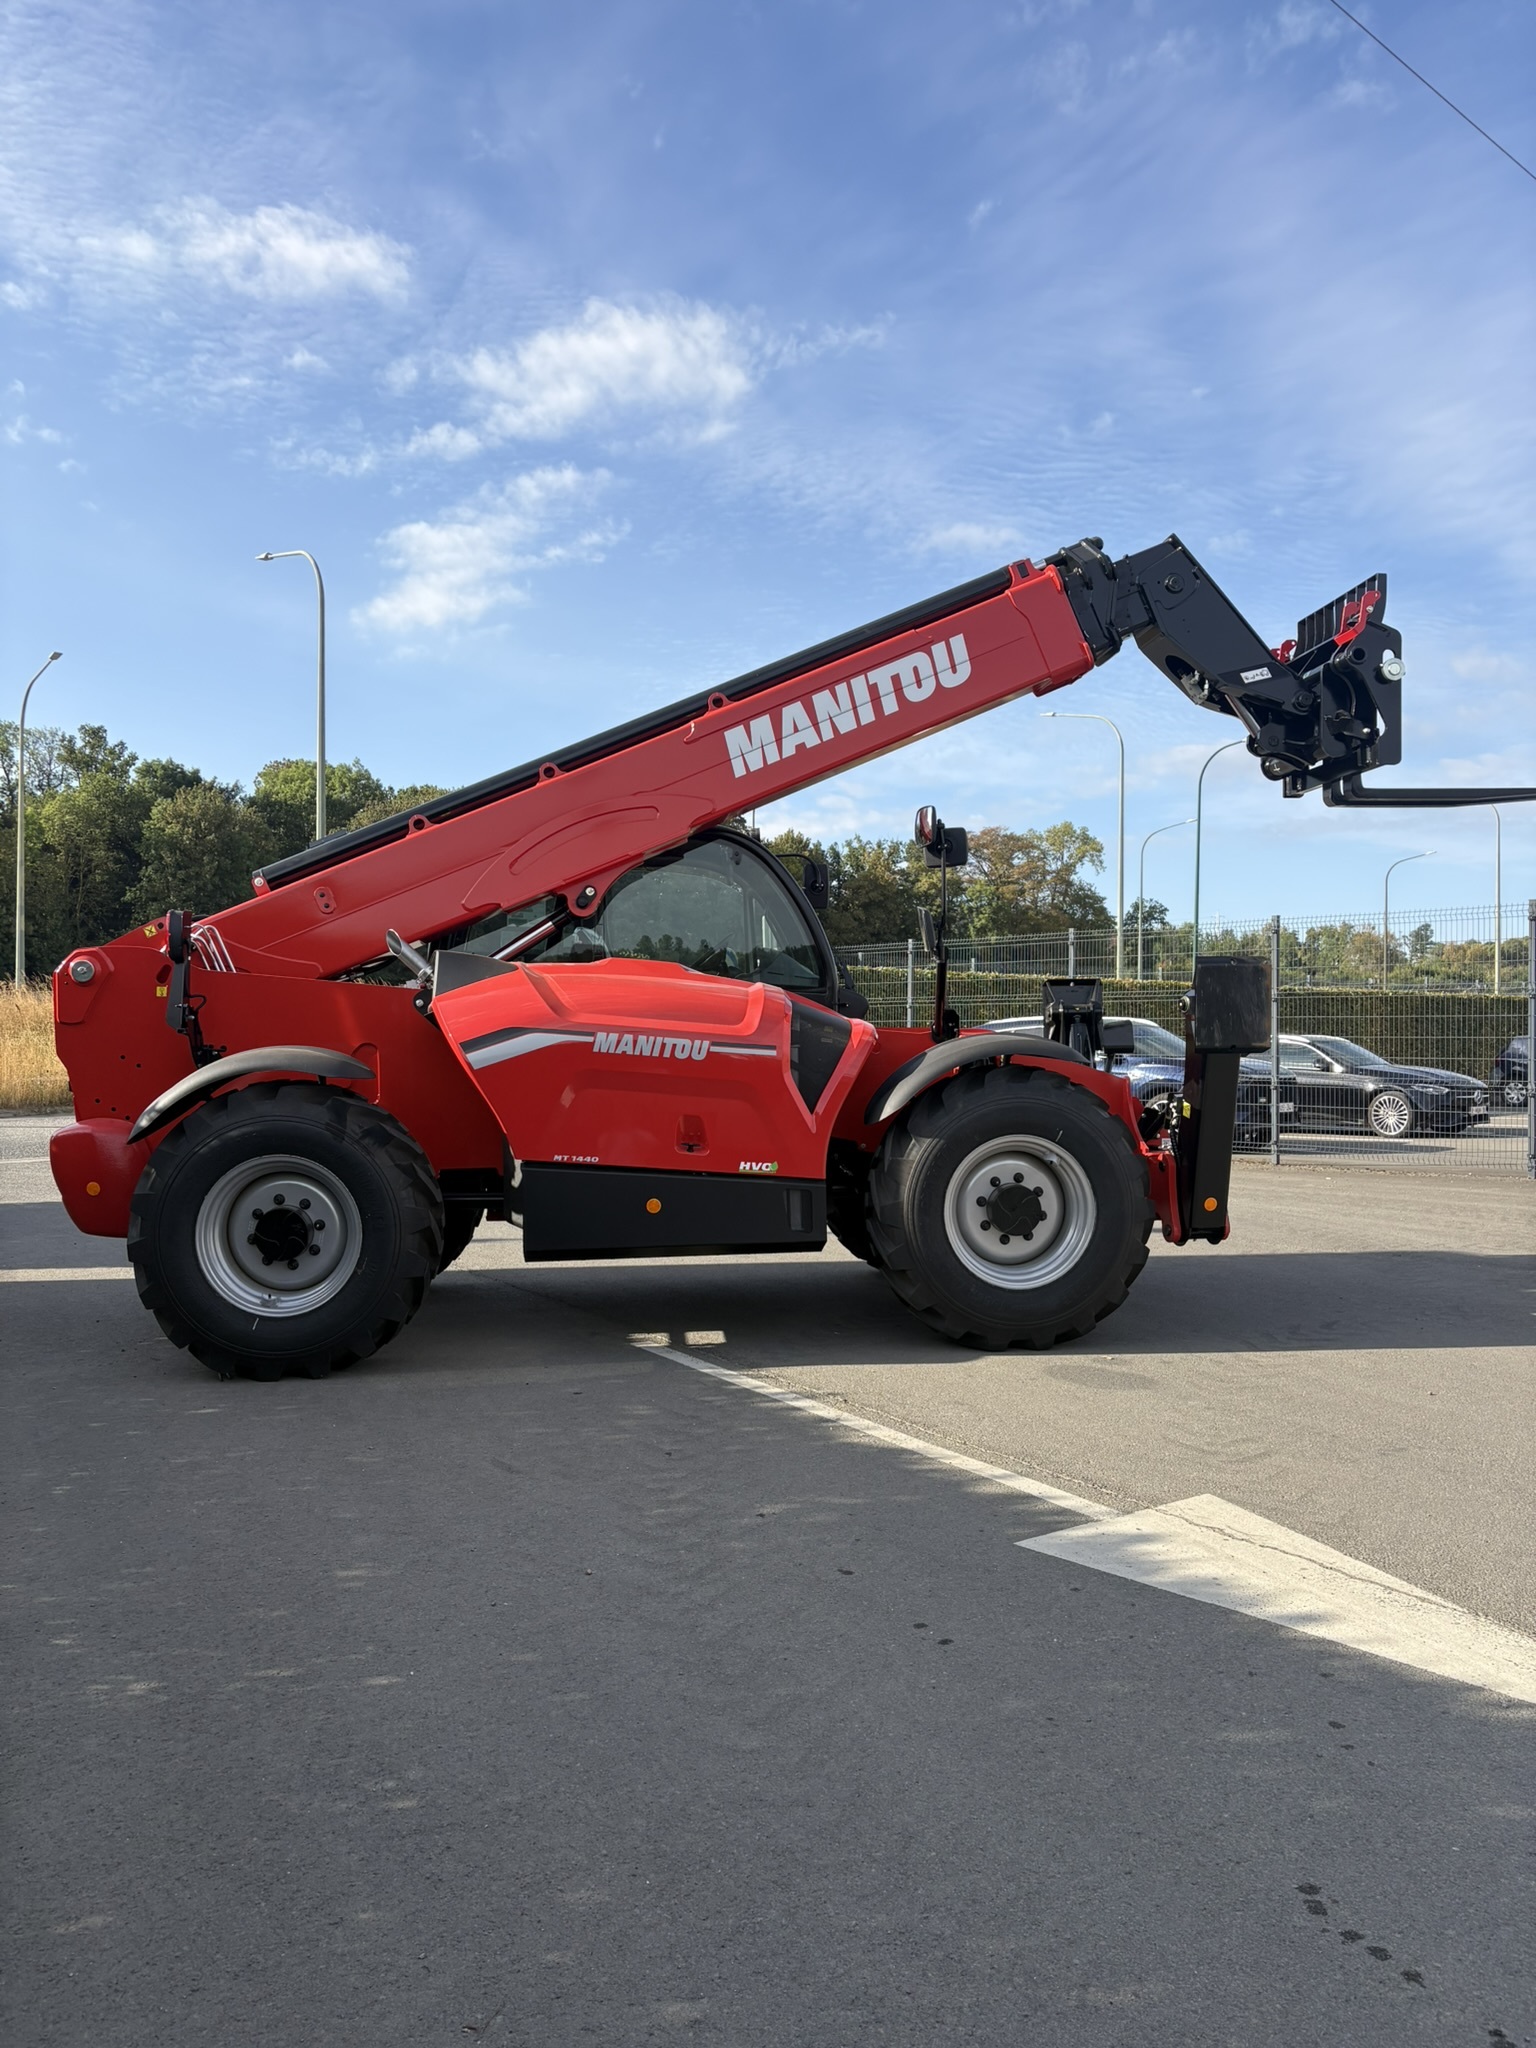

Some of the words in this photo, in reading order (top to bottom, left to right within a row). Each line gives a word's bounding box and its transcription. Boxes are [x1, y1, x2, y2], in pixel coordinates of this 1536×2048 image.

[724, 633, 972, 778] MANITOU
[593, 1031, 710, 1061] MANITOU
[571, 1155, 600, 1163] 1440
